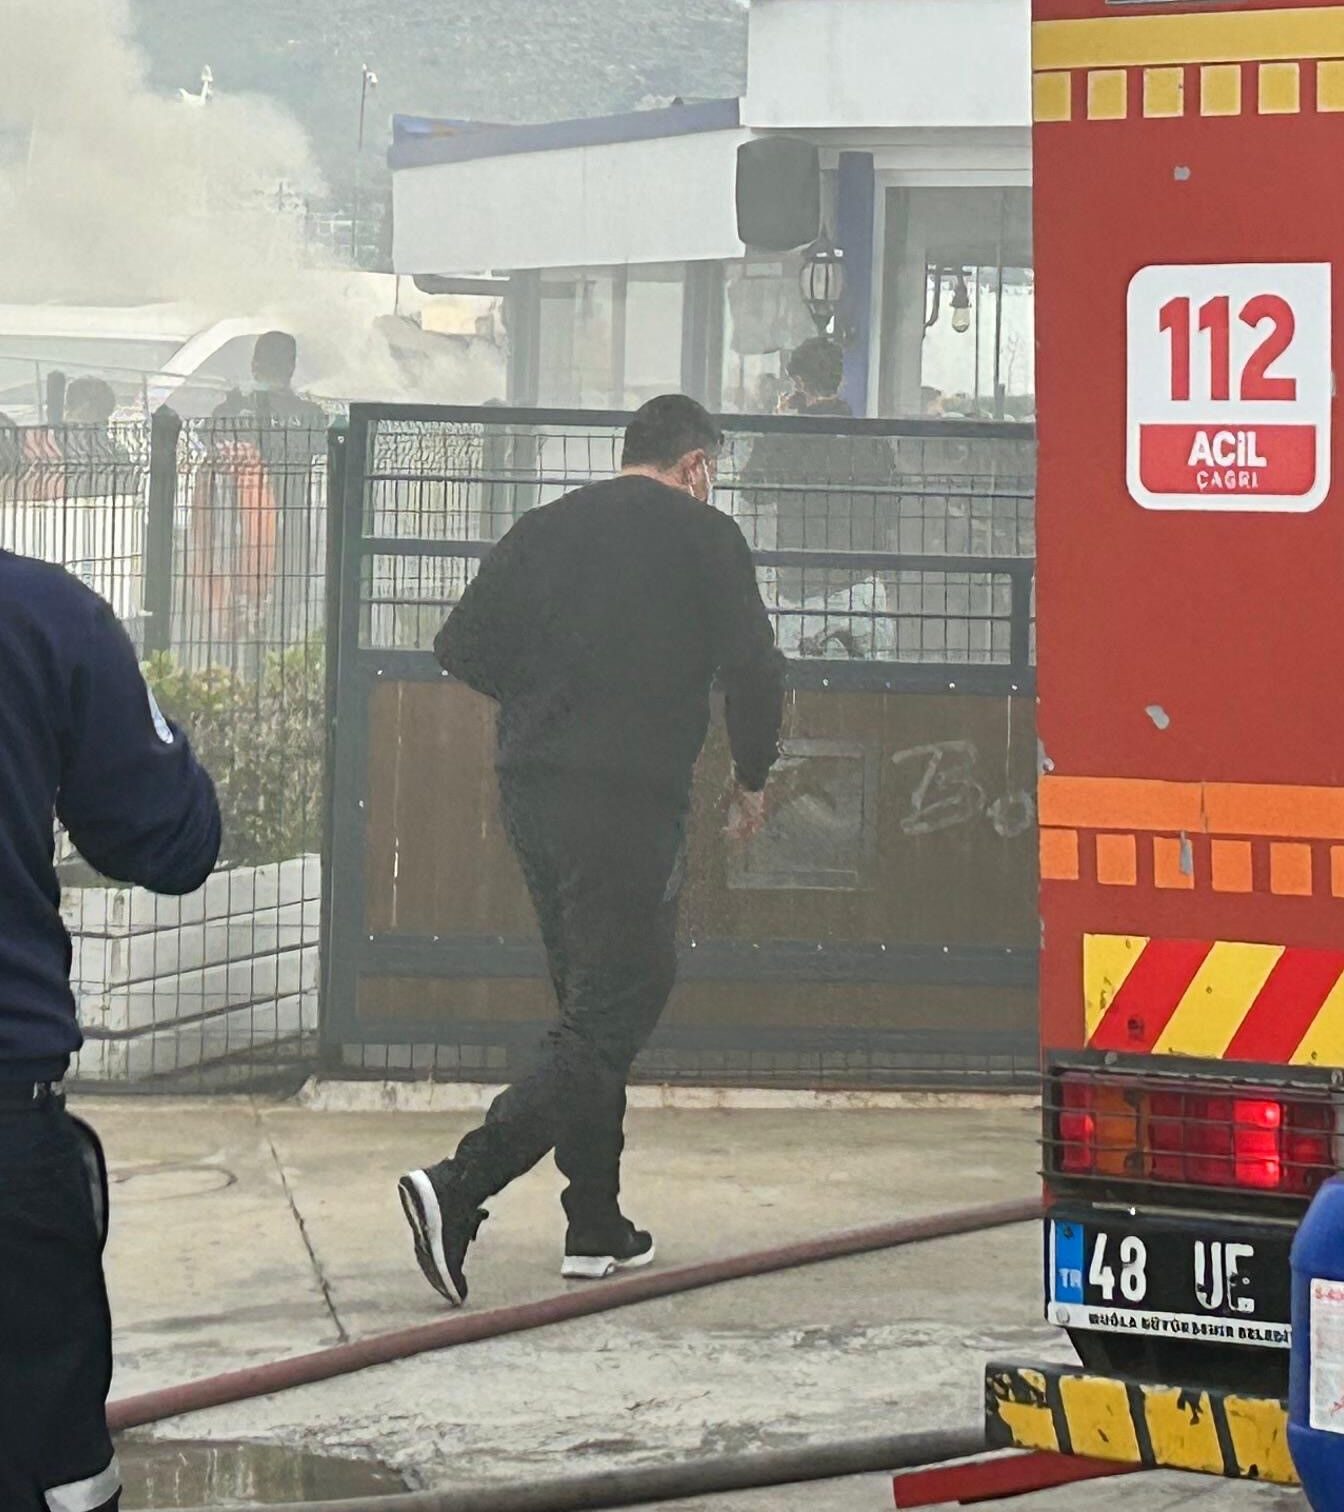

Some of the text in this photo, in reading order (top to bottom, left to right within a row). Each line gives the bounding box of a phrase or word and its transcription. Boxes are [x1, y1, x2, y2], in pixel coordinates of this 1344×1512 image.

[1159, 293, 1297, 401] 112
[1058, 1268, 1083, 1289] TR
[1089, 1232, 1148, 1303] 48
